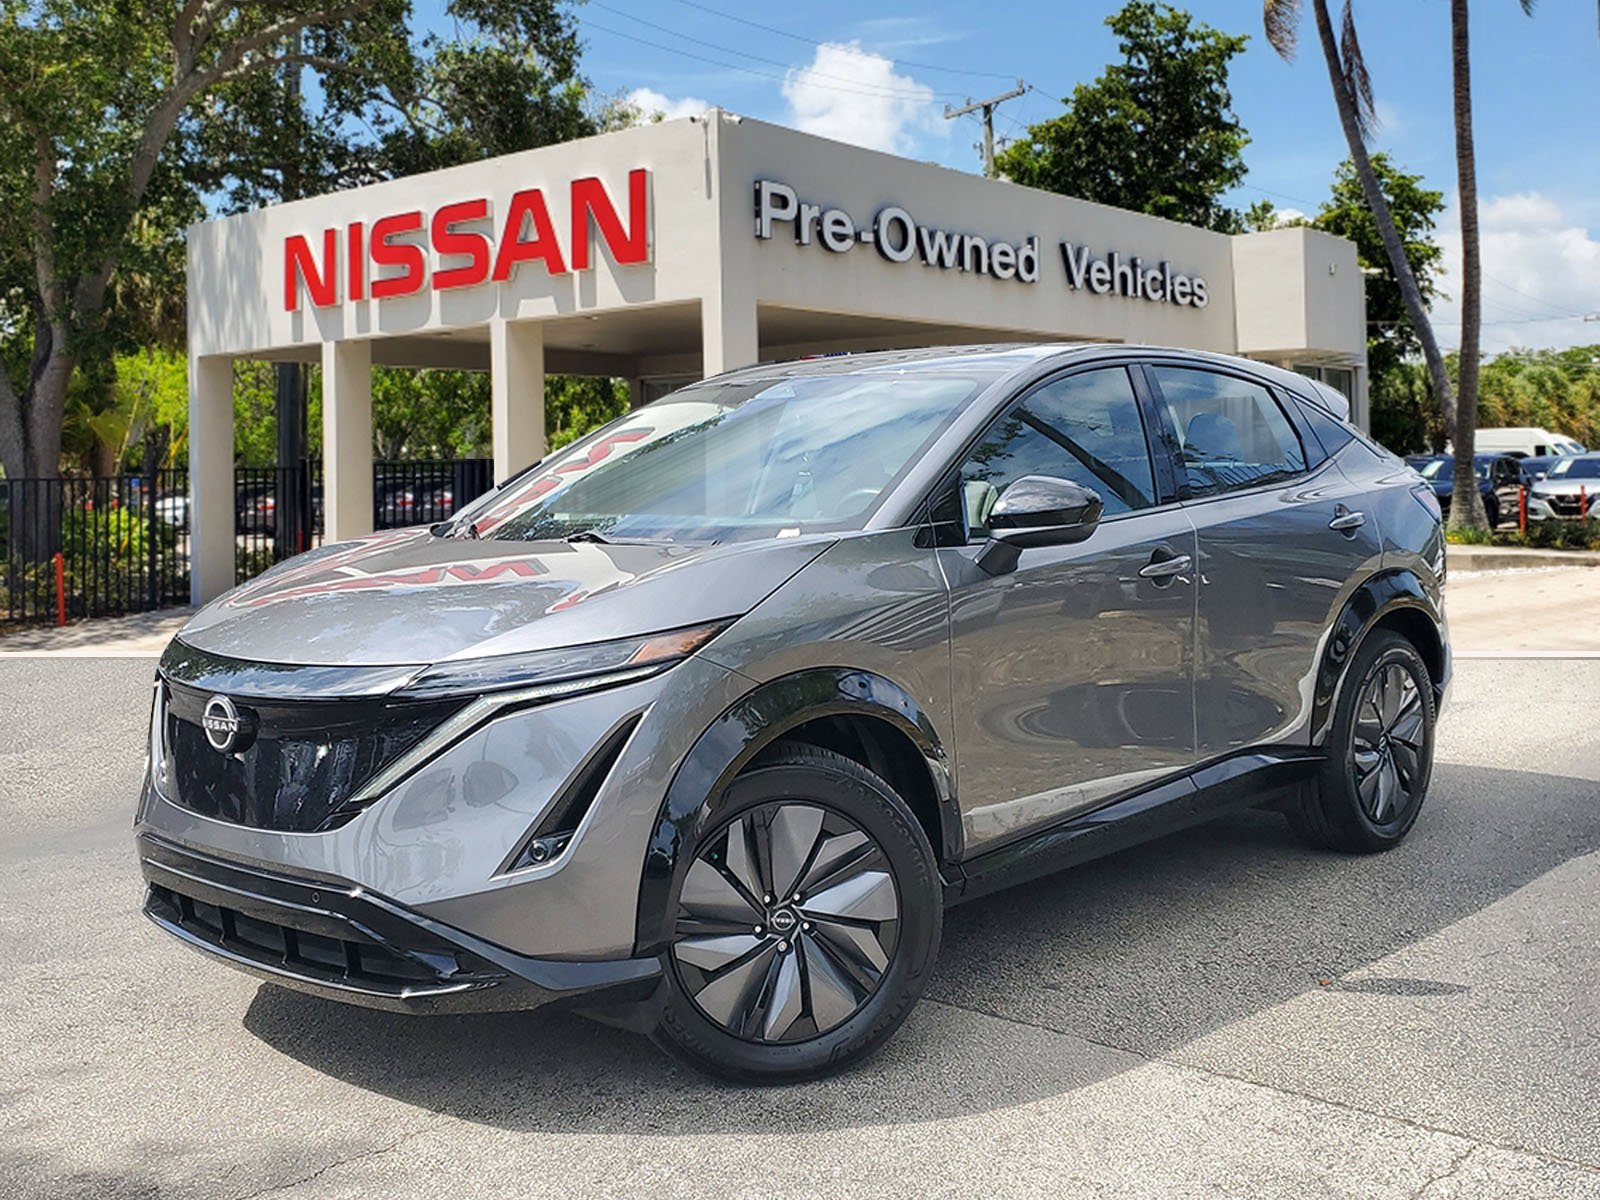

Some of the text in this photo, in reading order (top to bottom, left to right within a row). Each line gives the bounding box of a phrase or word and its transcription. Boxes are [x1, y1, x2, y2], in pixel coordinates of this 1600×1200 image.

[284, 168, 648, 312] NISSAN
[754, 180, 1209, 309] Pre-Owned Vehicles
[202, 718, 238, 732] SSAN
